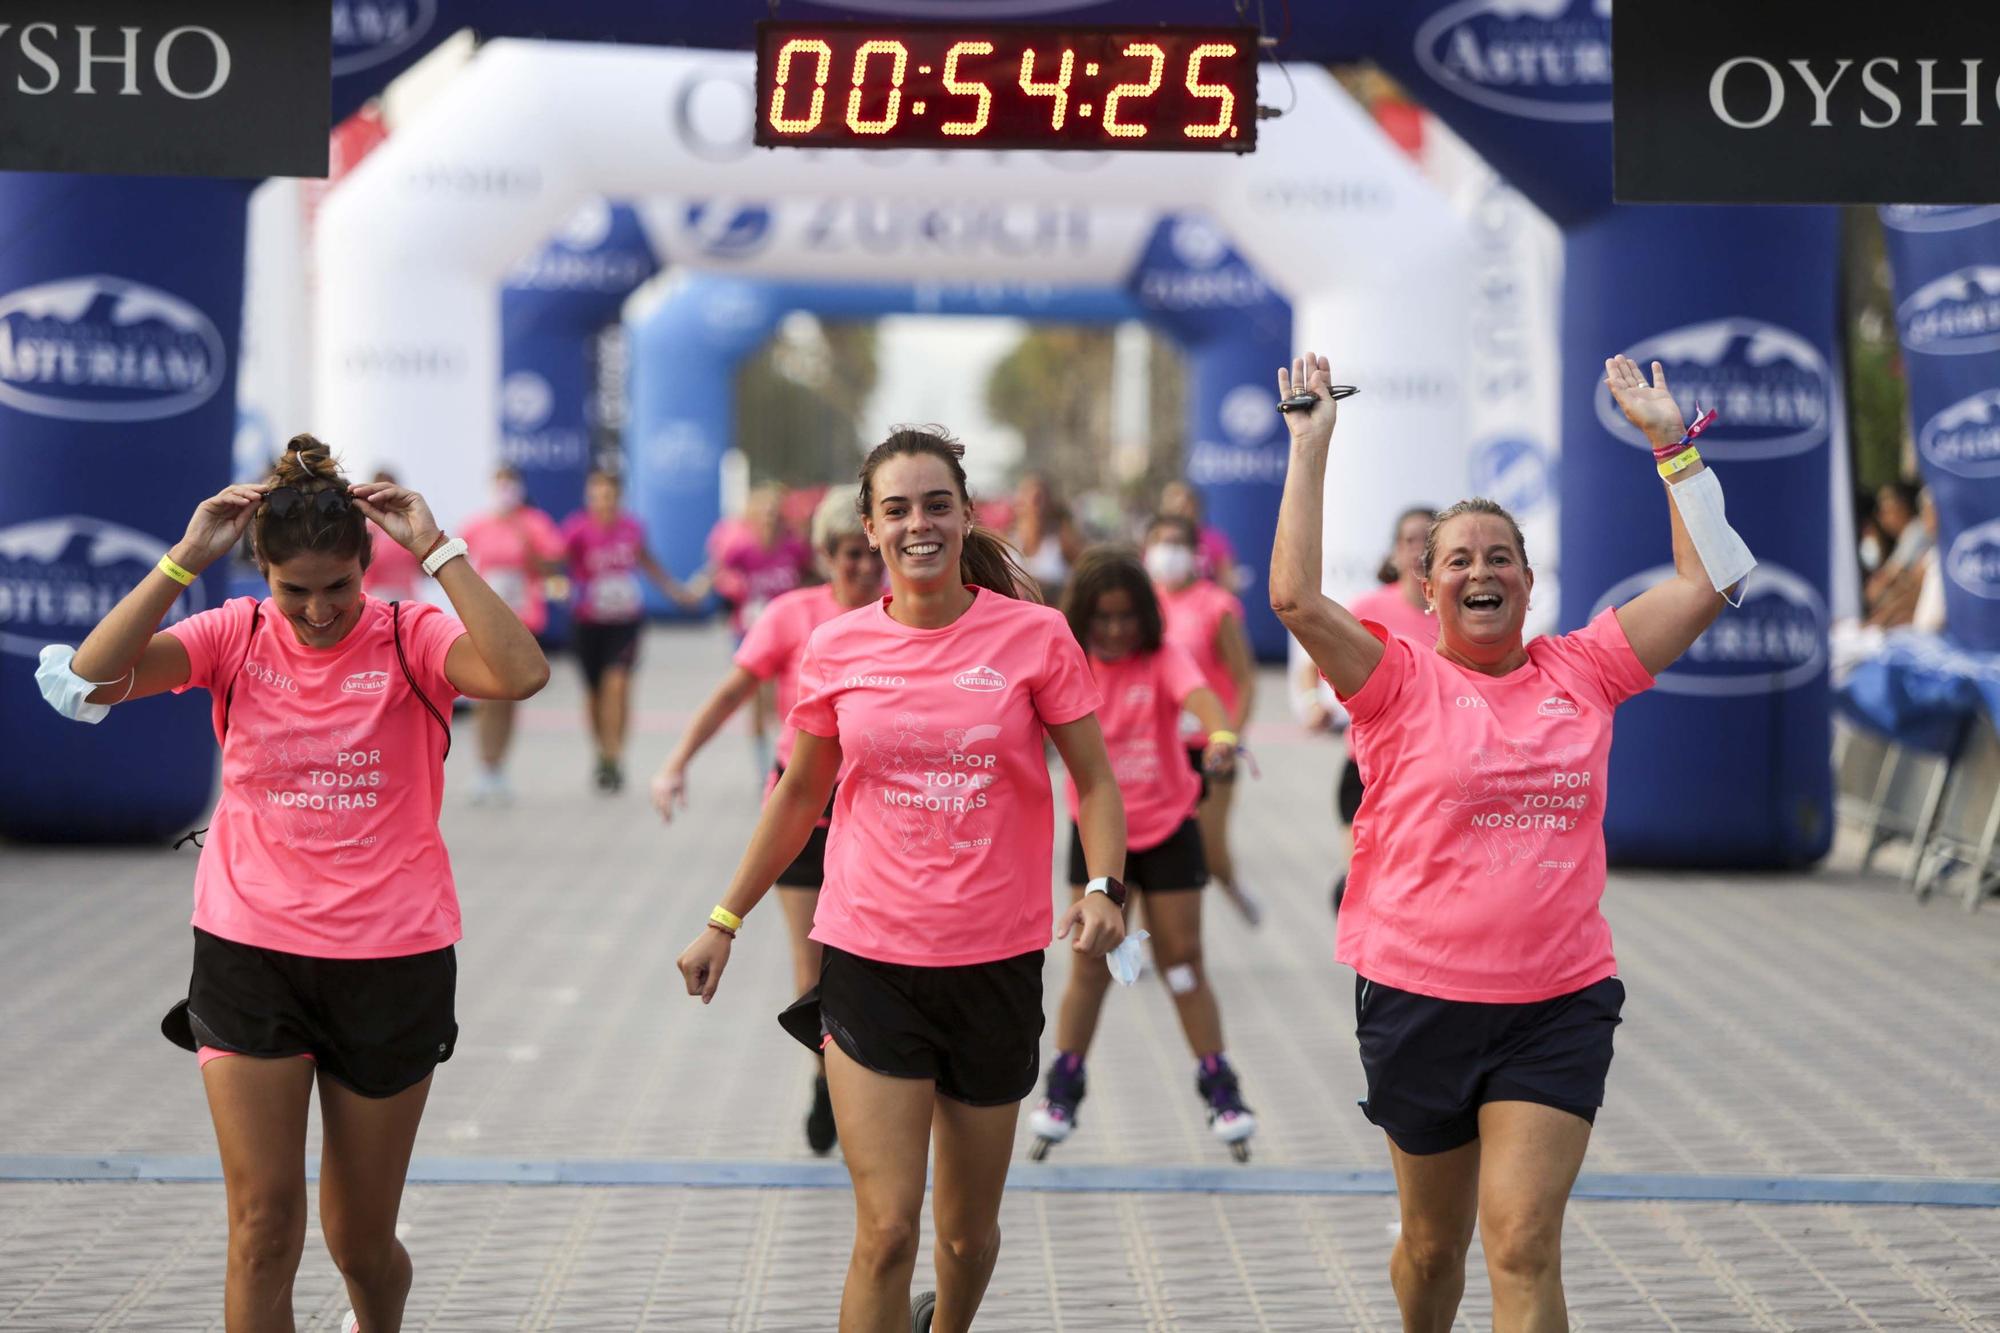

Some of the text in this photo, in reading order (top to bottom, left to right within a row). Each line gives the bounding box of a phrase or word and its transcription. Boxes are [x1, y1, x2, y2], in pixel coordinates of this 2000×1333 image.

[0, 22, 231, 100] SHO
[1708, 56, 2000, 129] OYSH
[246, 662, 298, 692] OYSHO
[845, 675, 905, 689] OYSHO
[959, 676, 1003, 687] ASTURIANA
[337, 750, 380, 766] POR
[952, 754, 996, 768] POR
[309, 771, 380, 788] TODAS
[1553, 772, 1590, 789] POR
[267, 790, 377, 811] NOSOTRAS
[884, 789, 987, 813] NOSOTRAS
[1523, 794, 1586, 809] TODAS
[1471, 813, 1578, 831] NOSOTRAS
[972, 838, 992, 847] 2021
